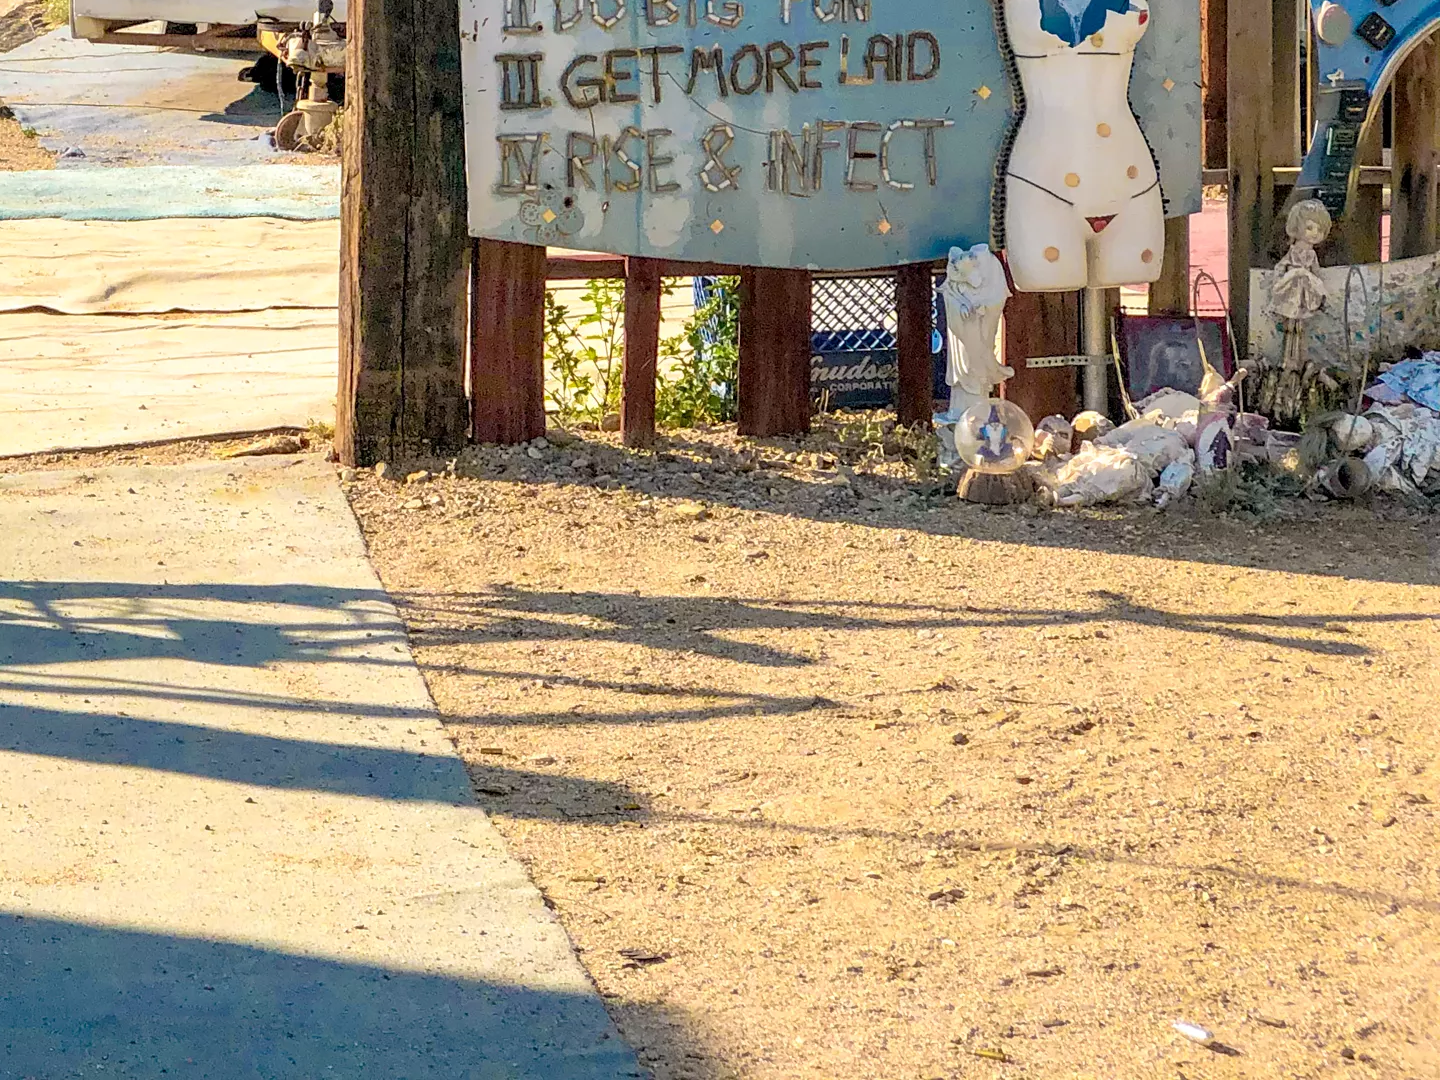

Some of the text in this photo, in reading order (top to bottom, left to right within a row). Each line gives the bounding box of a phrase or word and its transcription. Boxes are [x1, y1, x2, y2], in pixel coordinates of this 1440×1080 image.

[560, 44, 685, 110] GET
[686, 39, 830, 98] MORE
[838, 29, 941, 87] LAID
[566, 124, 682, 194] RISE
[699, 121, 742, 193] &
[765, 118, 957, 197] INFECT
